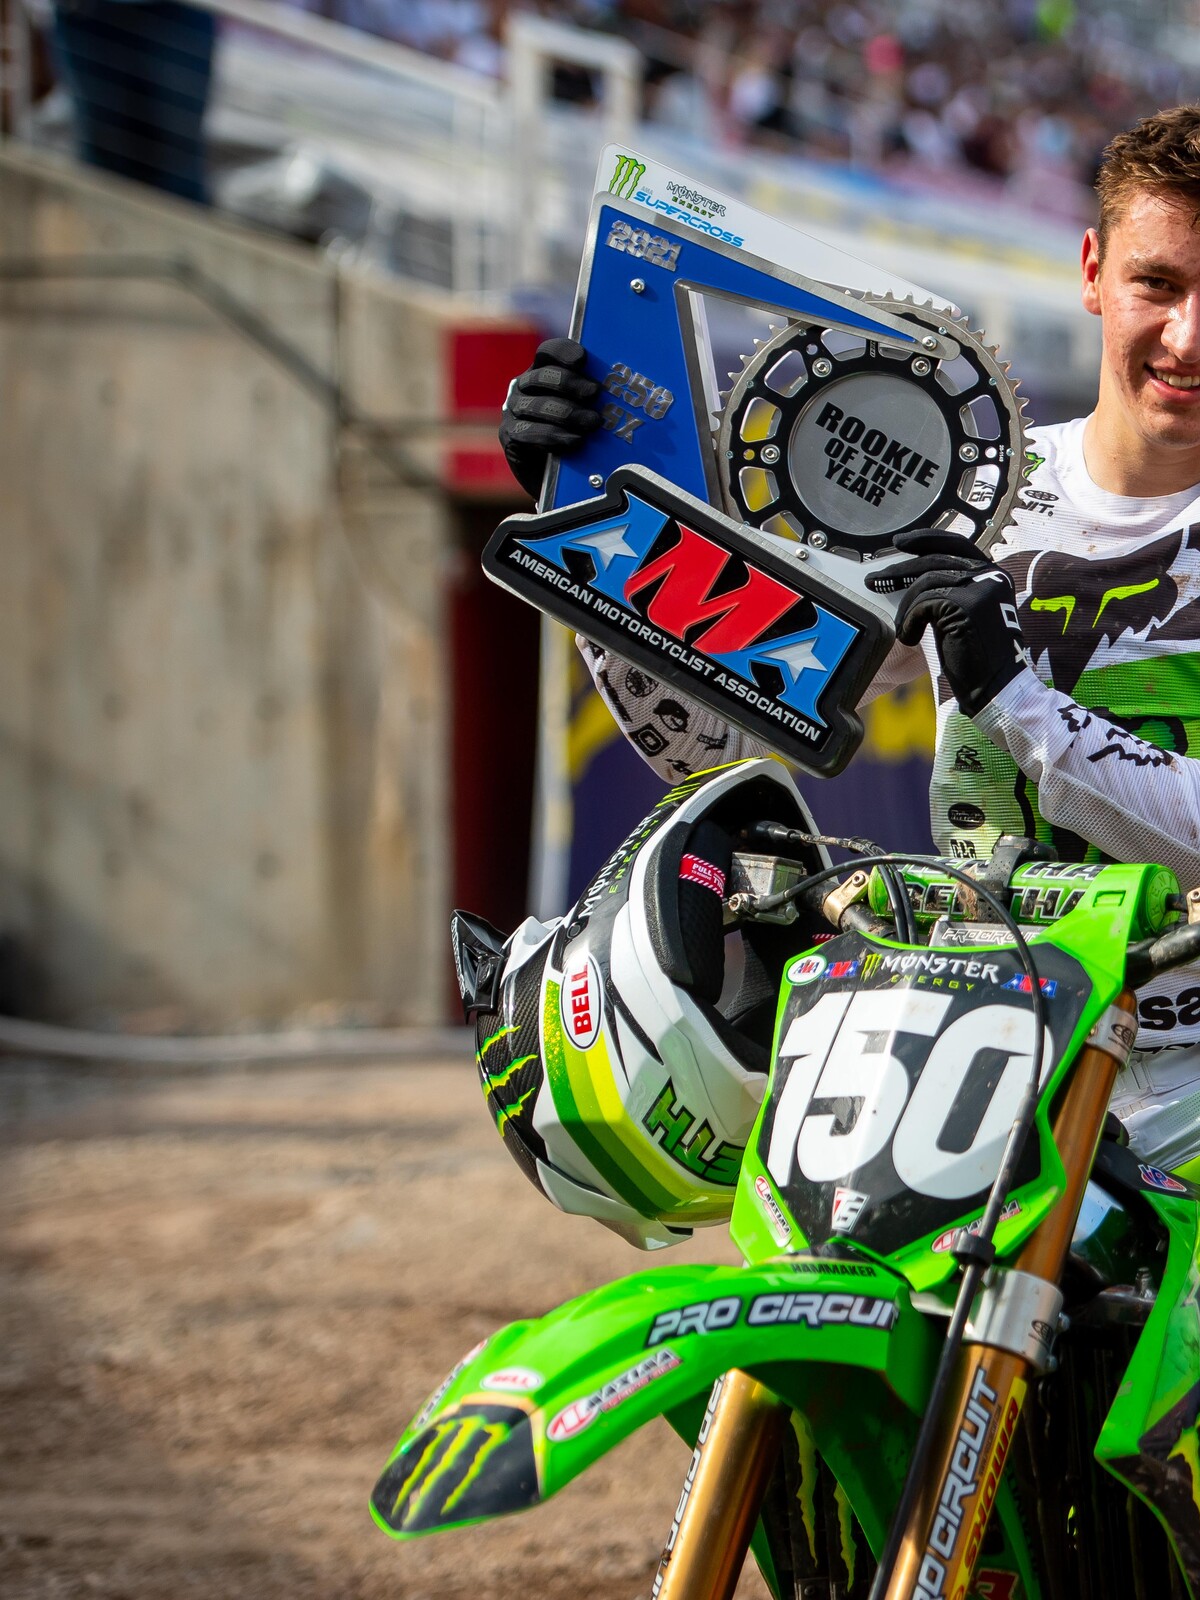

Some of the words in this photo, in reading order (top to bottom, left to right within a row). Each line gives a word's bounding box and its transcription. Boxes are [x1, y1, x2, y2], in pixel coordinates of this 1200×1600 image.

[633, 191, 745, 248] SUPERCROSS
[815, 401, 940, 488] ROOKIE
[824, 437, 859, 465] OF
[858, 456, 908, 496] THE
[824, 458, 887, 507] YEAR
[511, 488, 861, 728] AMA
[508, 549, 593, 606] AMERICAN
[593, 597, 715, 677] MOTORCYCLIST
[714, 671, 822, 743] ASSOCIATION
[692, 863, 712, 877] PULL
[571, 961, 593, 1035] BELL
[880, 951, 1001, 985] MONSTER
[890, 974, 976, 993] ENERGY
[767, 987, 1055, 1200] 150
[791, 1262, 877, 1278] HAMMAKER
[645, 1294, 743, 1348] PRO
[586, 1349, 675, 1411] MAXIMA
[928, 1364, 999, 1561] CIRCUIT
[964, 1396, 1019, 1570] SHOWA
